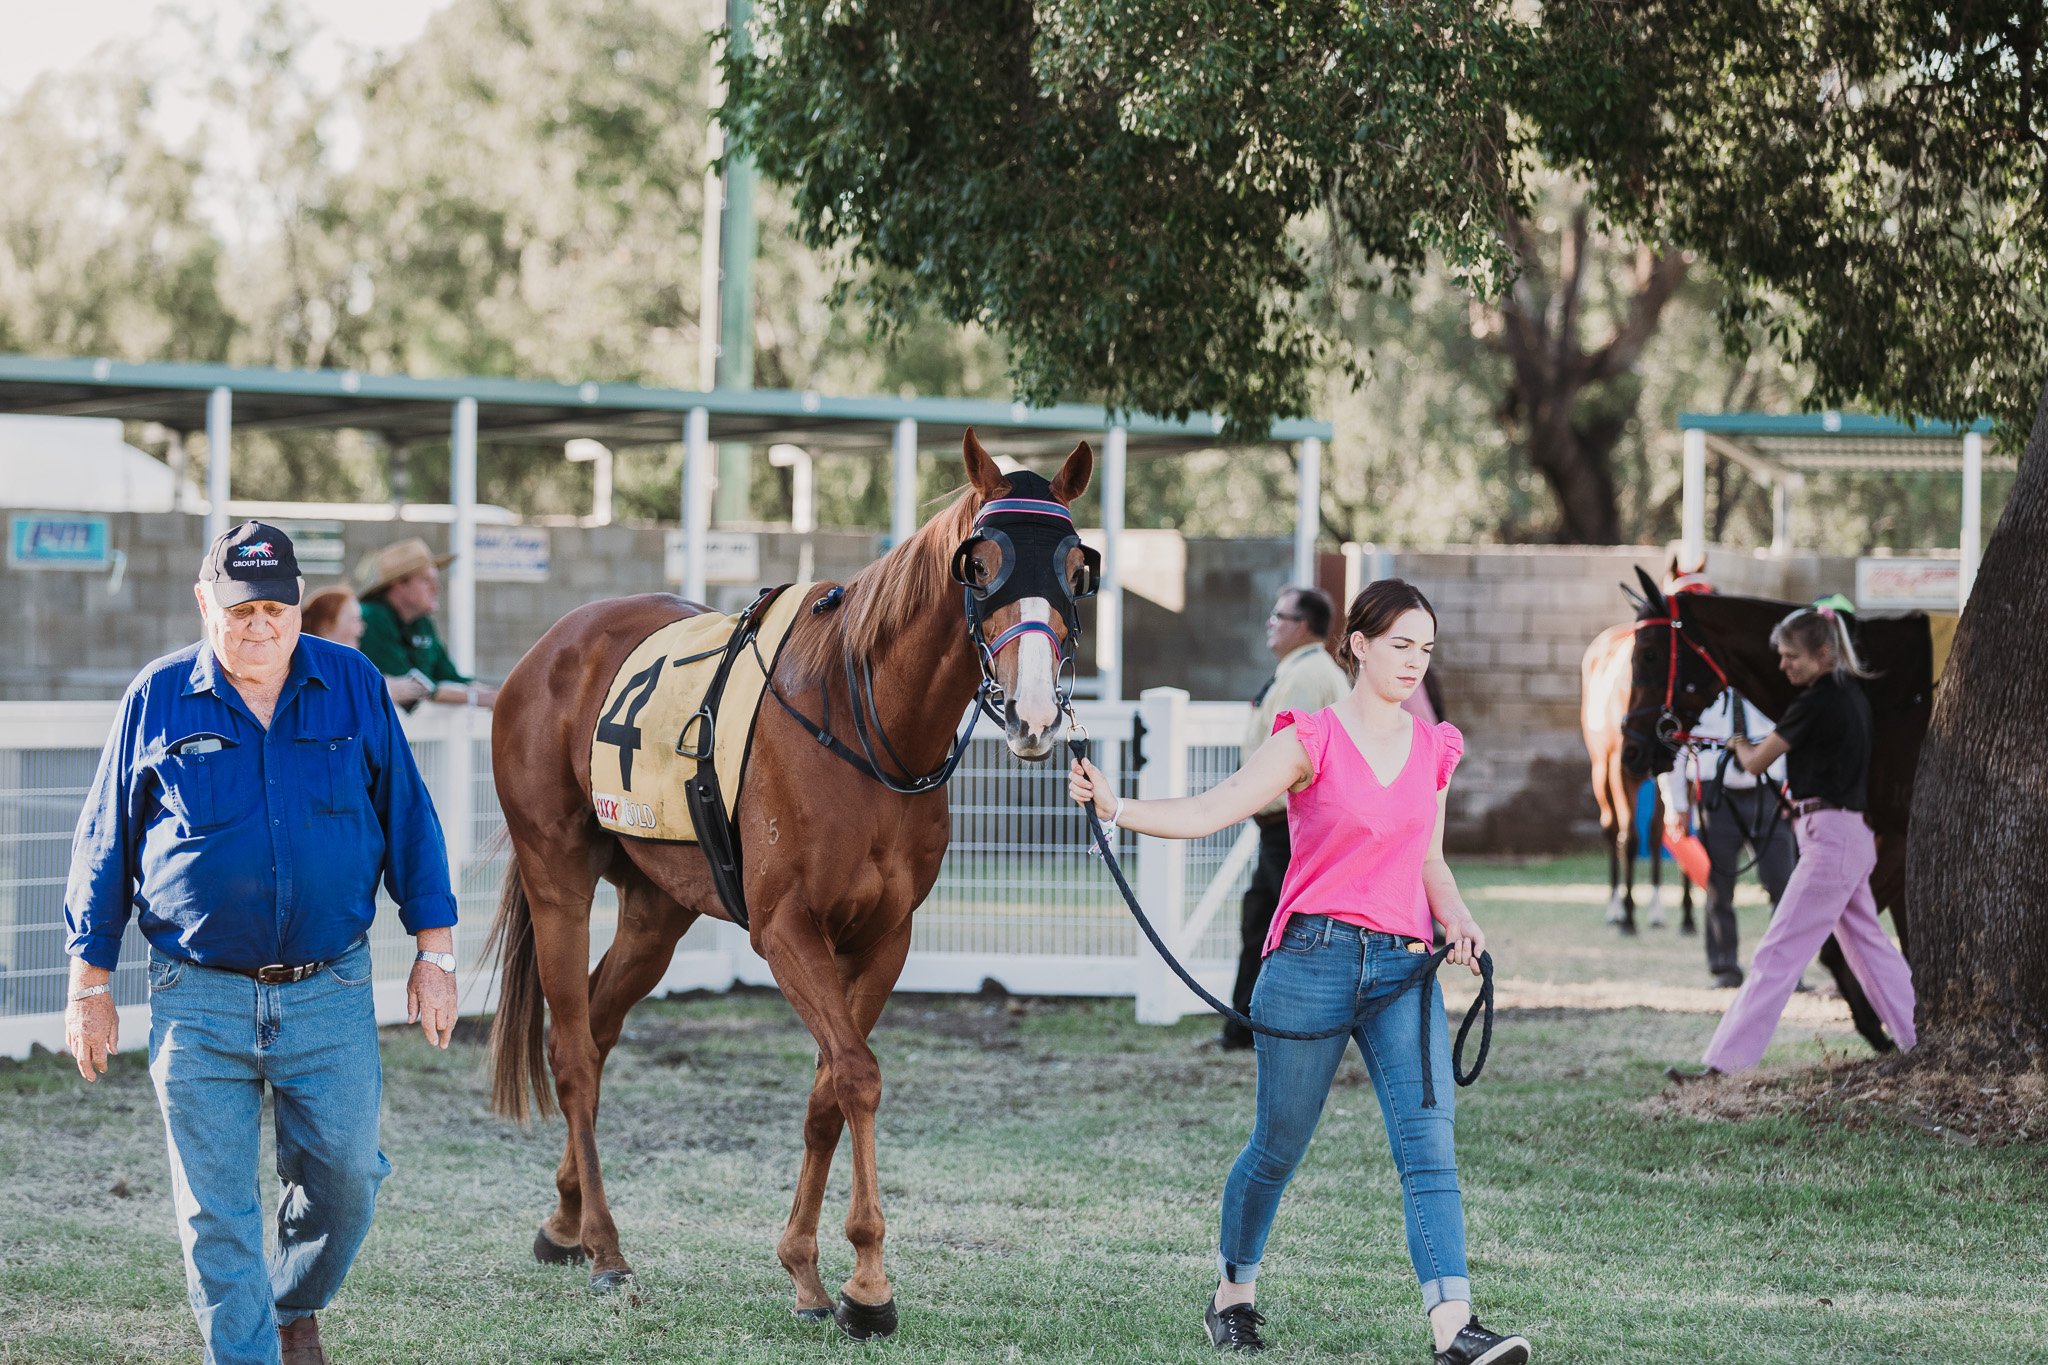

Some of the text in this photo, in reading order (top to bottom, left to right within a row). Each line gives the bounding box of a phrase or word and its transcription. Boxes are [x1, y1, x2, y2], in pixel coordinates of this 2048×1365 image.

[596, 654, 668, 792] 4
[625, 799, 657, 829] GOLD
[768, 816, 779, 845] 5
